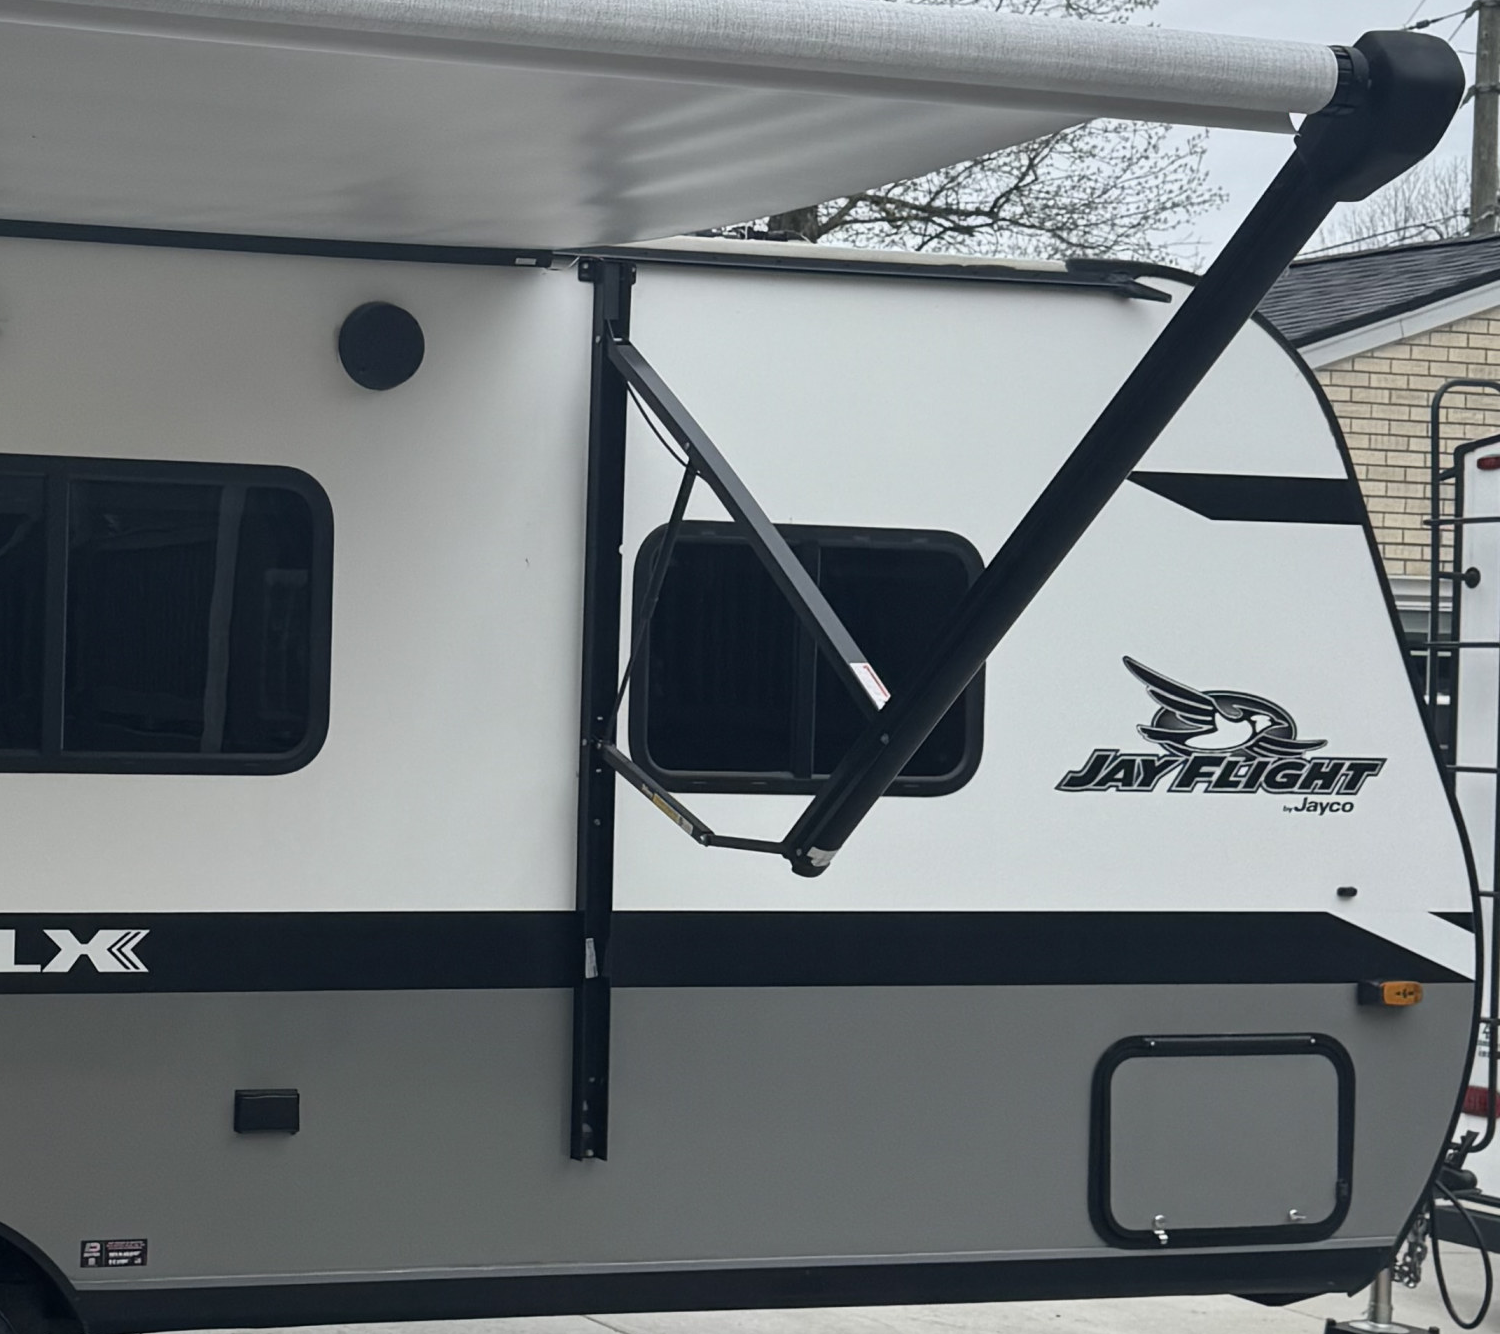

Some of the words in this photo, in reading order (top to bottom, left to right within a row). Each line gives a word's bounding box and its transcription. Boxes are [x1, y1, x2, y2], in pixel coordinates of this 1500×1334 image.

[1055, 748, 1184, 792] JAY
[1166, 753, 1388, 796] FLIGHT
[1293, 796, 1355, 816] Jayco
